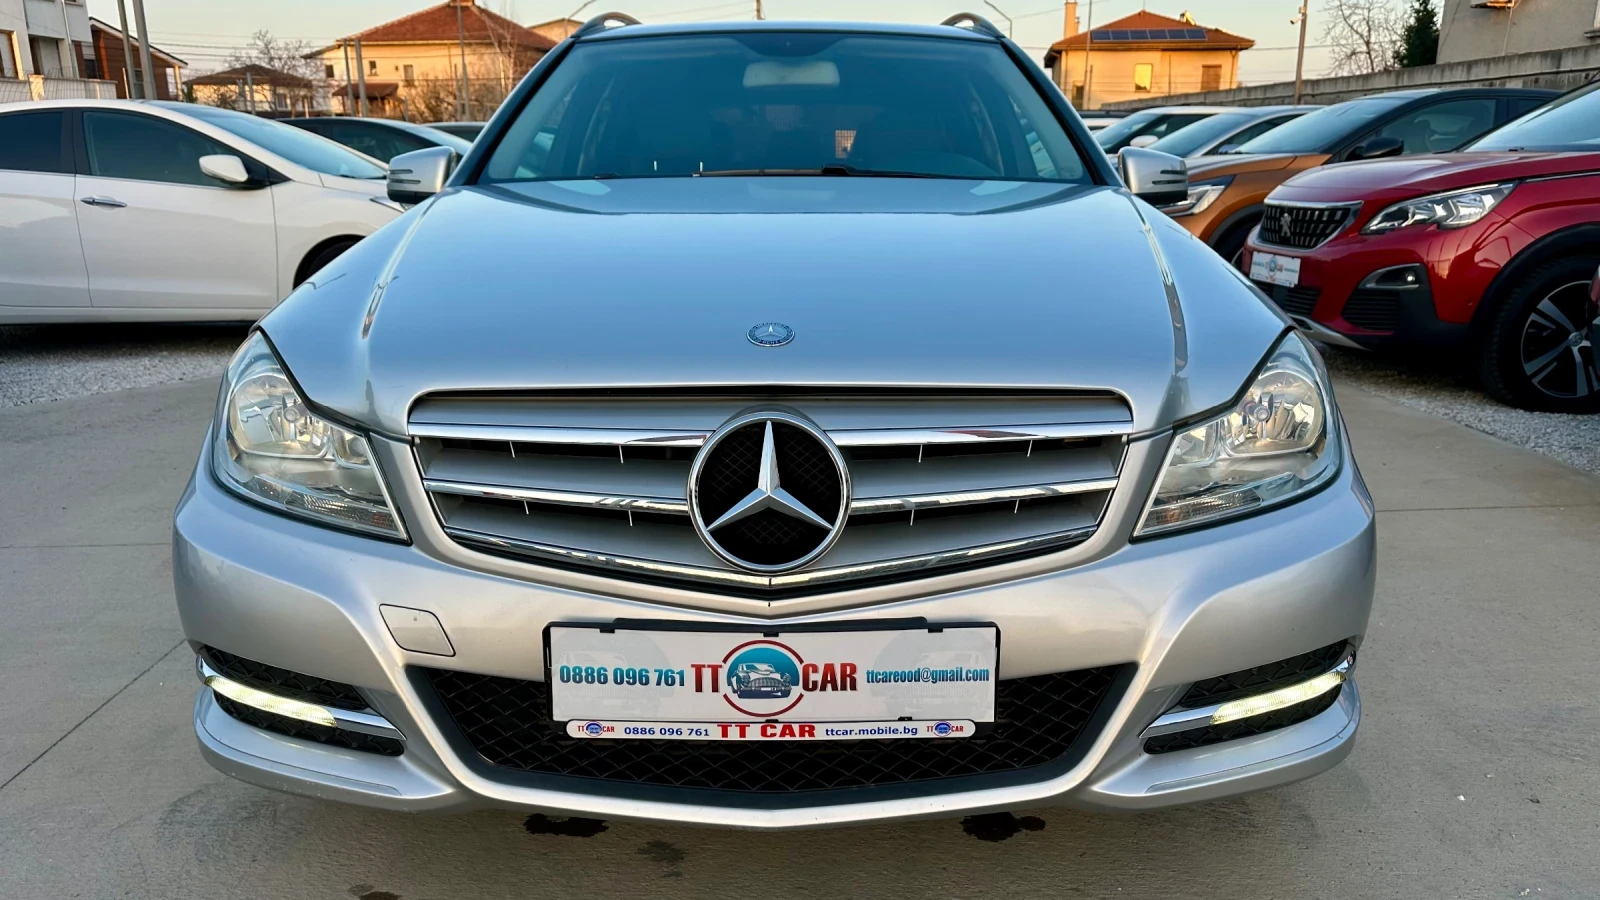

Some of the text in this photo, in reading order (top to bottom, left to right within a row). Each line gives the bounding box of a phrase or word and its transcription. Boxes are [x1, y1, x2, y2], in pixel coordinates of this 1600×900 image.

[559, 662, 990, 693] 0886 096 761 TT CAR ttcareood@gmail.com
[624, 727, 656, 735] 0886
[659, 728, 683, 736] 096
[687, 728, 710, 737] 761
[717, 724, 750, 738] TT
[760, 723, 816, 738] CAR
[825, 725, 918, 736] ttcar.mobile.bg
